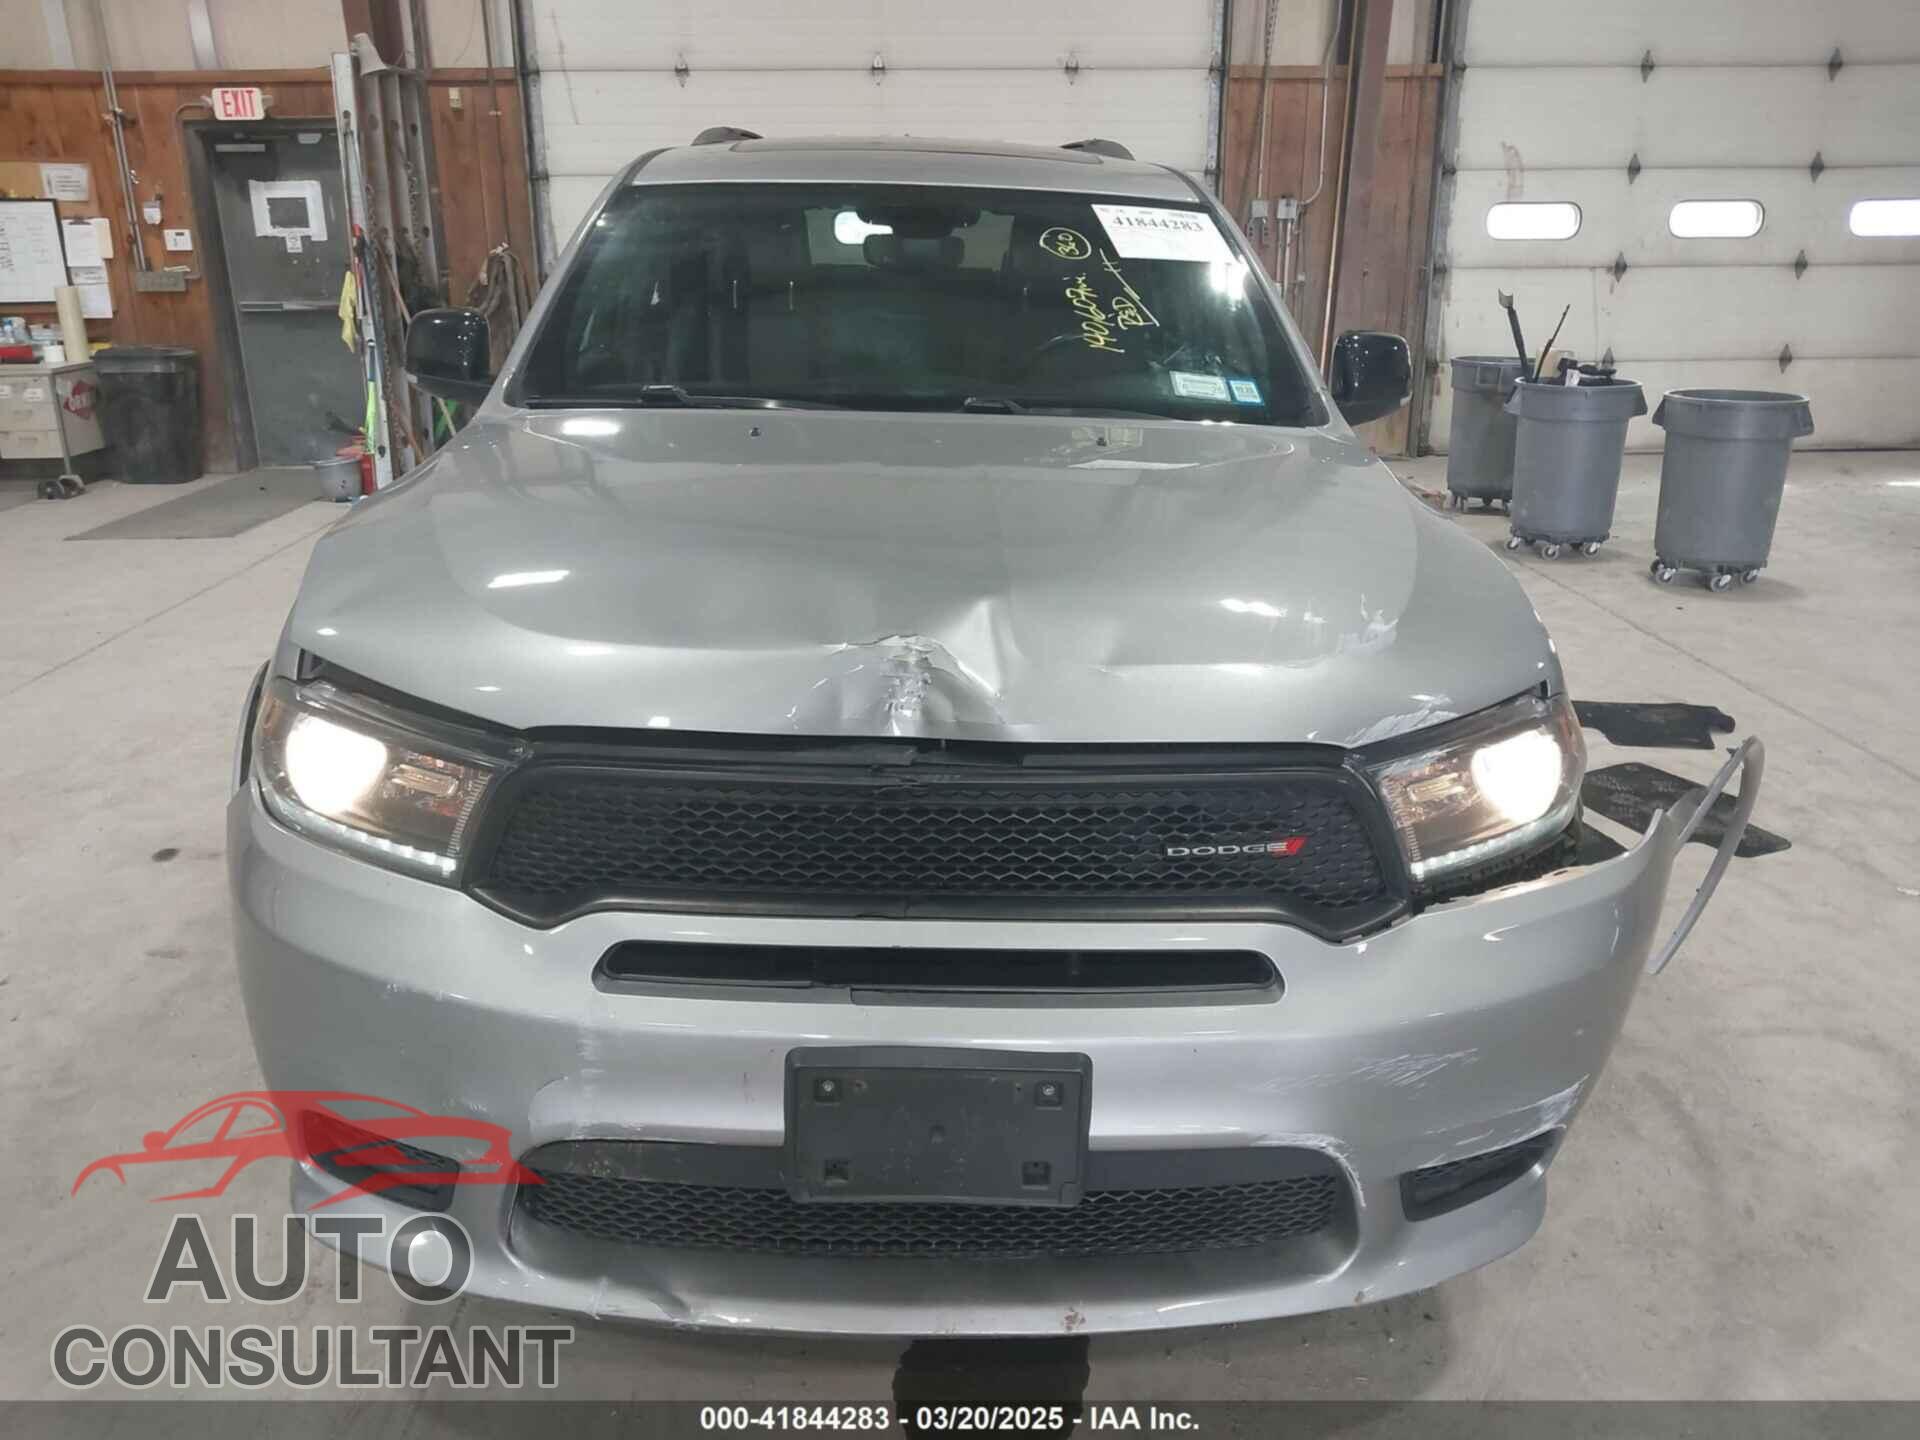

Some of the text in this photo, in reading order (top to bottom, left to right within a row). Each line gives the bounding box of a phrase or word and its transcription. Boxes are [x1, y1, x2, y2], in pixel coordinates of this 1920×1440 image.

[221, 90, 255, 117] EXIT
[1112, 215, 1204, 232] 41844283
[1167, 842, 1288, 856] DODGE
